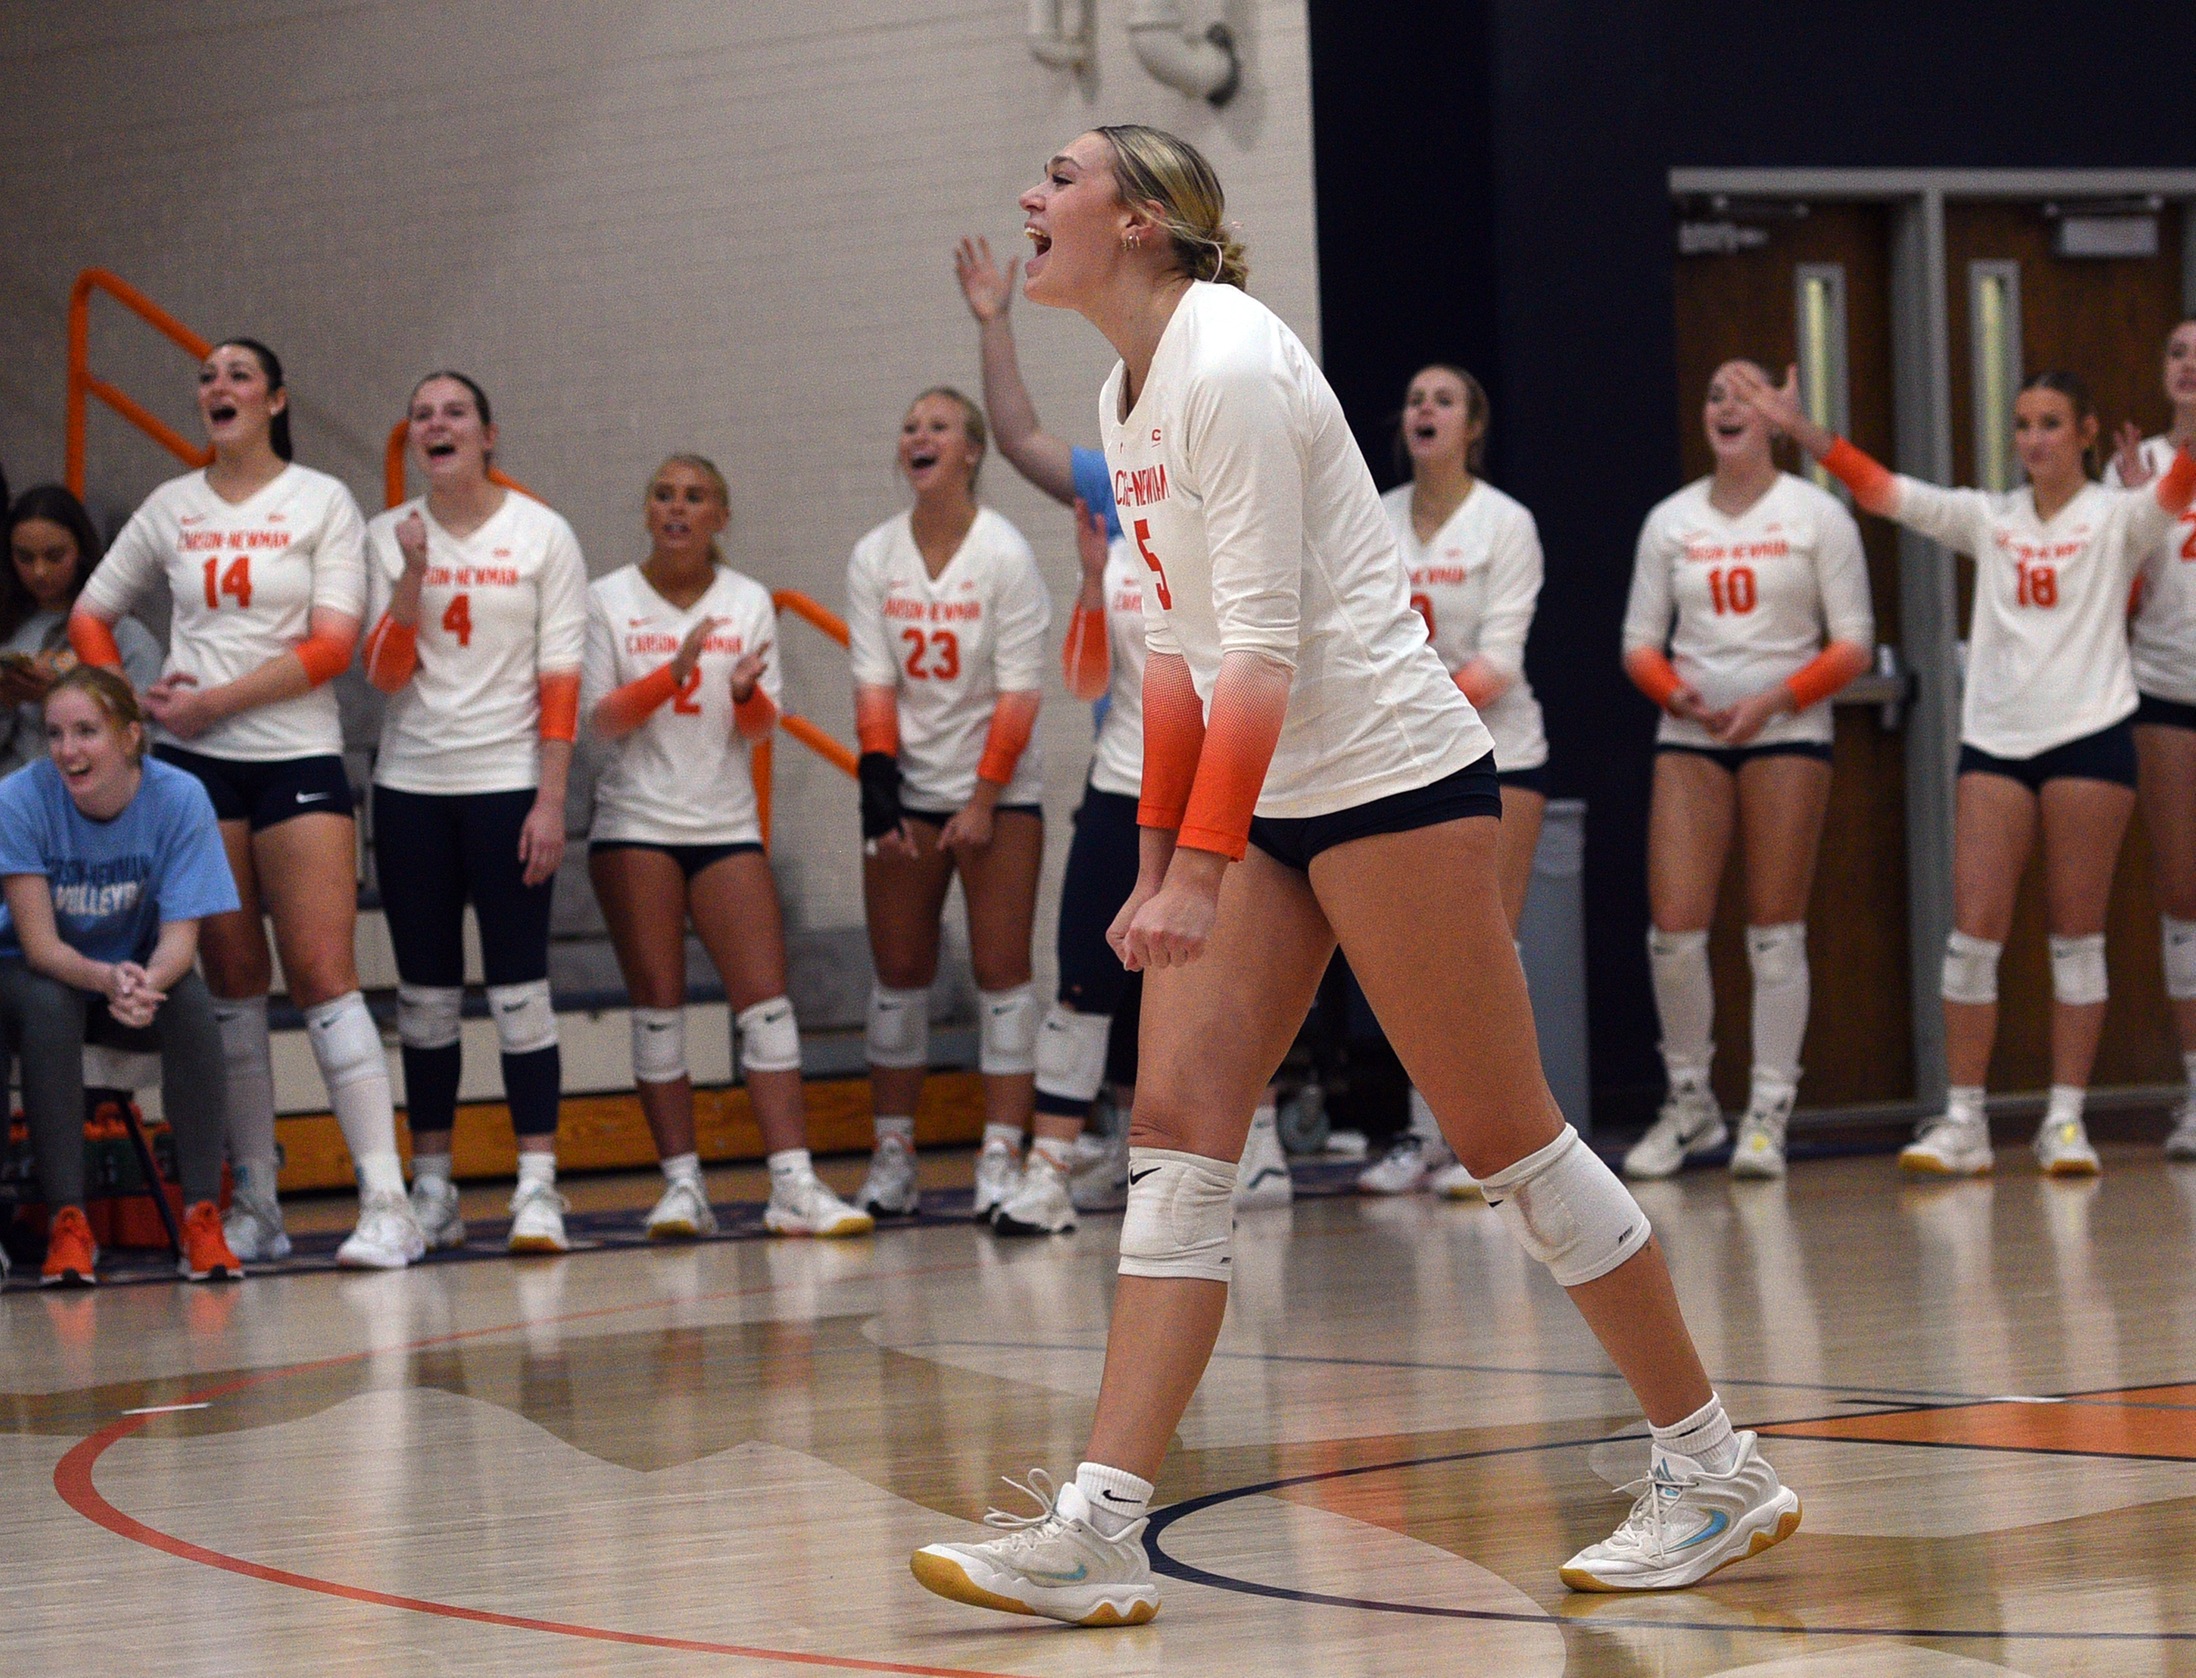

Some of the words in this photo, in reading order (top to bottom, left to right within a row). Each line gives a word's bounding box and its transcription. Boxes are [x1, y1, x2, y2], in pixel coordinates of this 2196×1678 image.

[203, 555, 252, 611] 14
[1133, 518, 1173, 610] 5
[2017, 561, 2058, 608] 18
[1709, 566, 1757, 616] 10
[443, 594, 471, 648] 4
[903, 628, 959, 681] 23
[673, 664, 703, 716] 2
